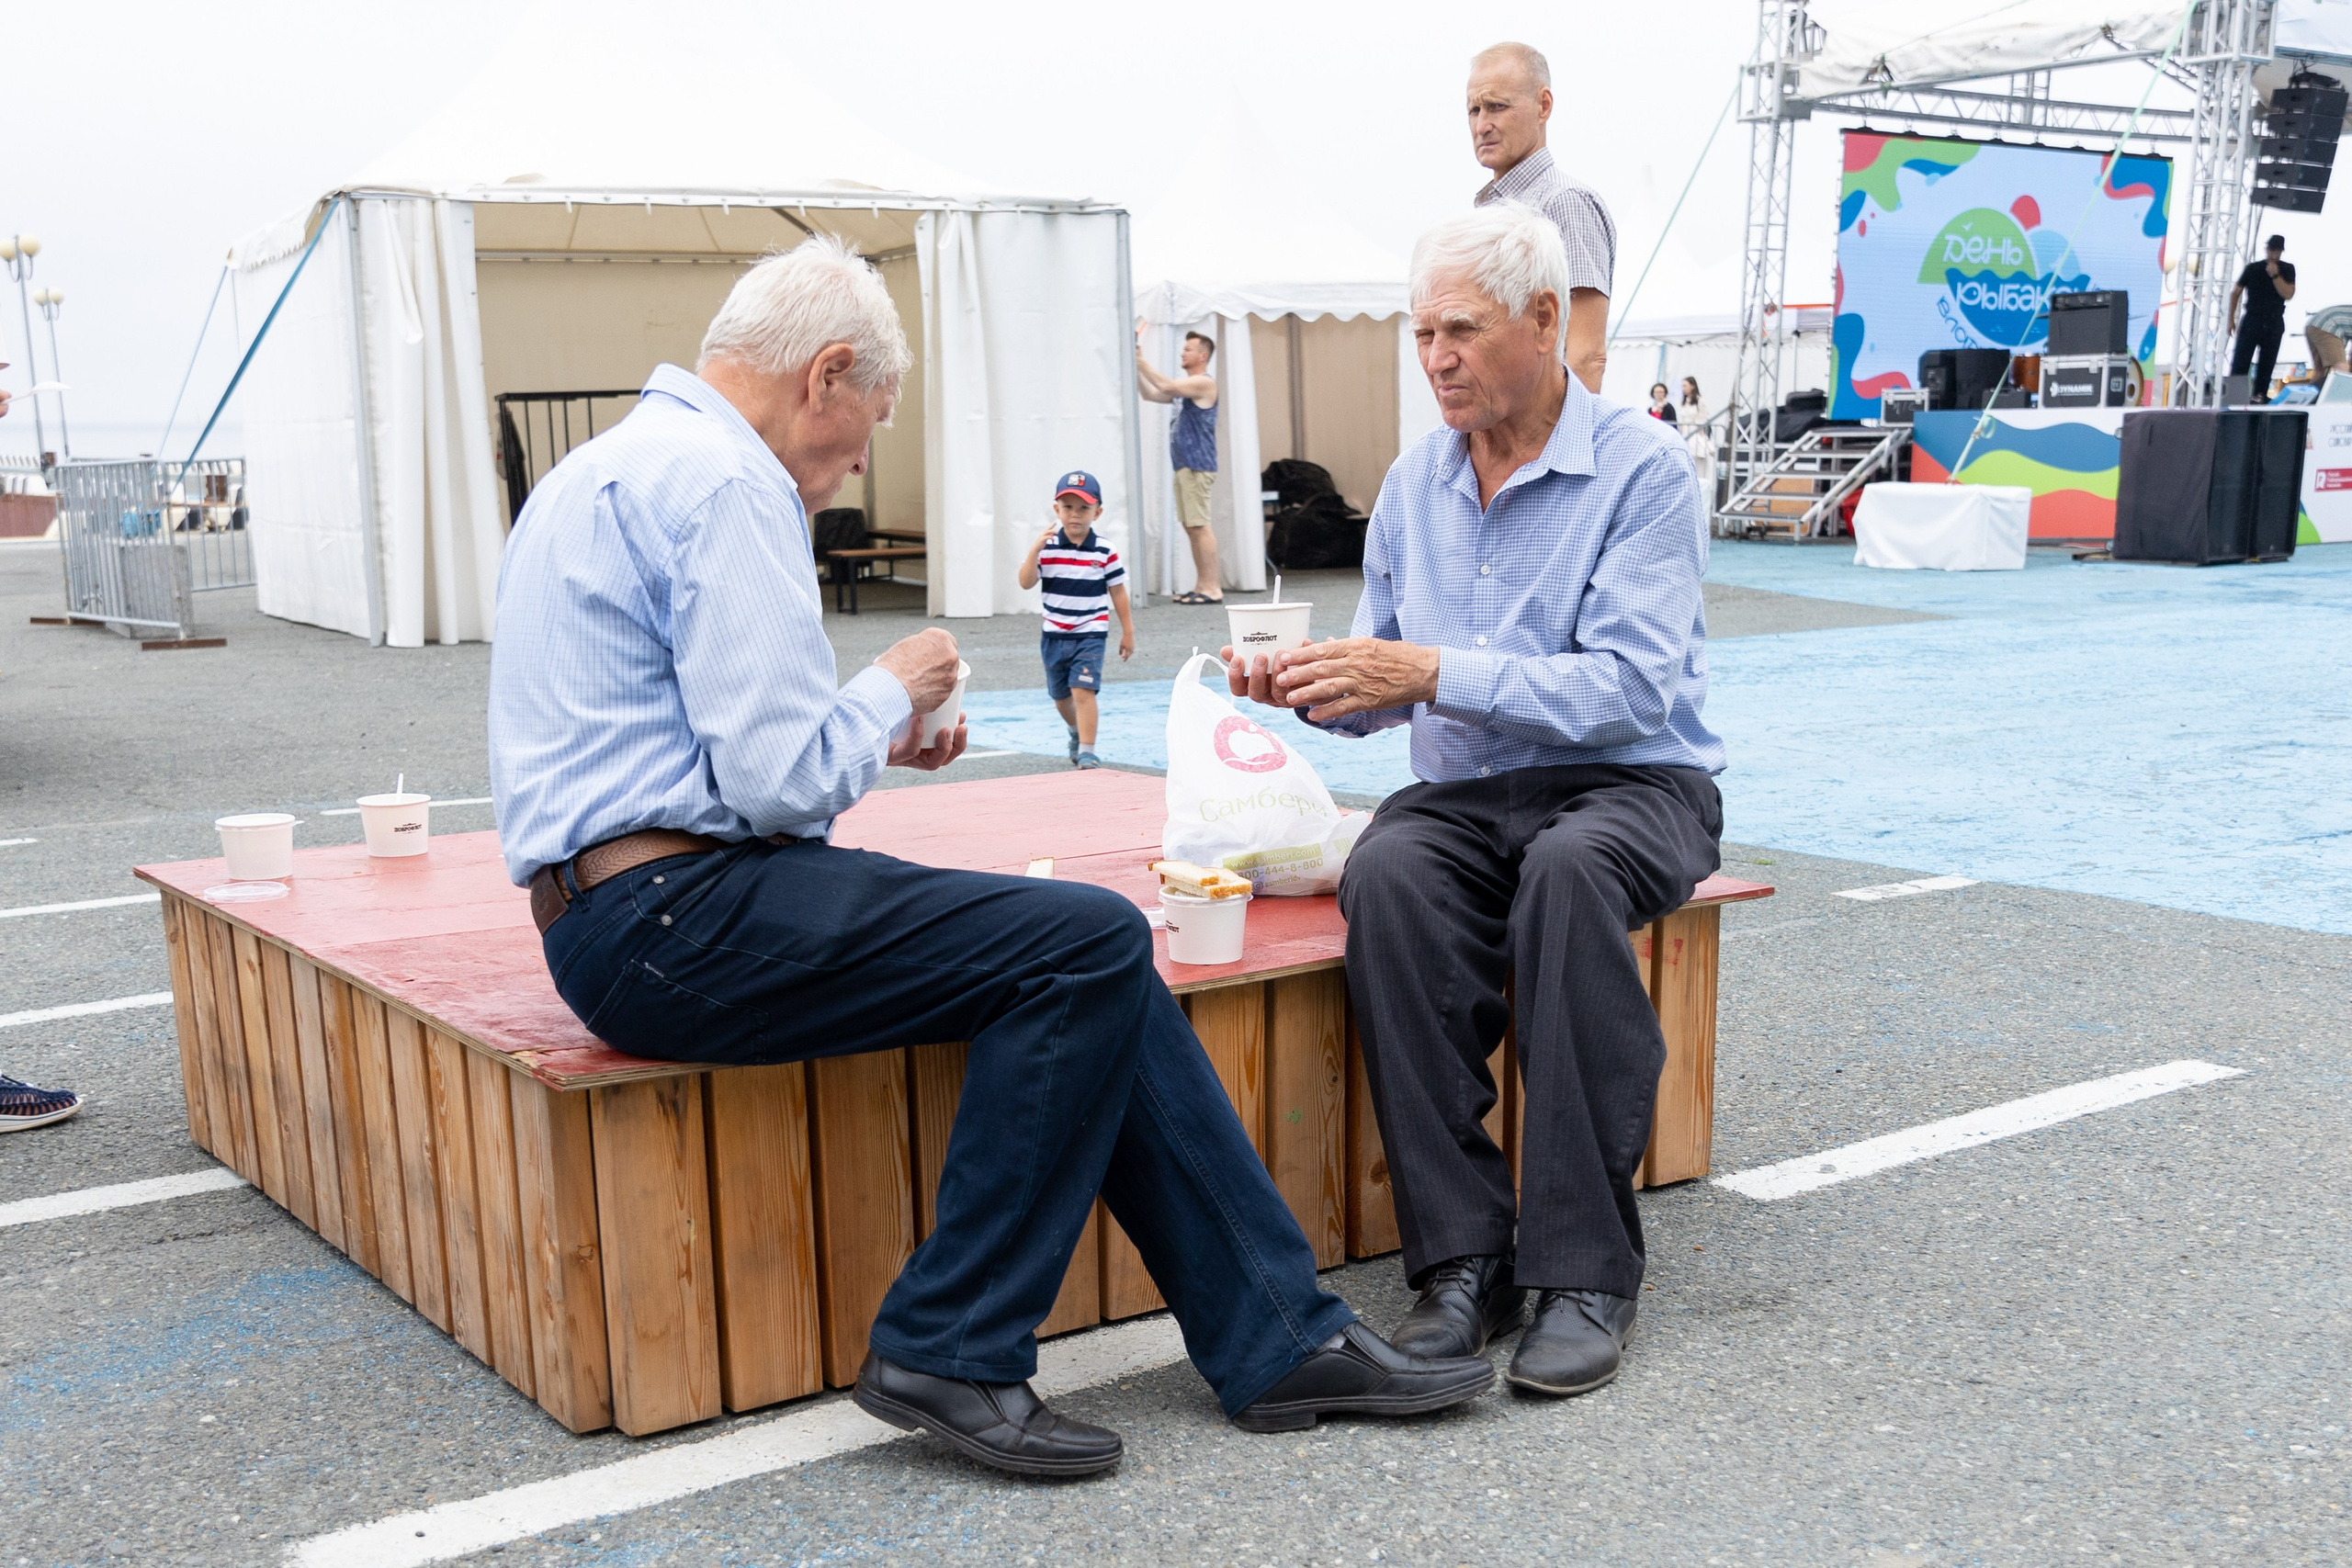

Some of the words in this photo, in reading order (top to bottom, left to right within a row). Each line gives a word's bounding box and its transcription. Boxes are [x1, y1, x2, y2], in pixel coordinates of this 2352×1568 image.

[1942, 234, 2024, 266] День
[1199, 785, 1328, 822] Самбери
[1230, 848, 1316, 868] www.samberi.com
